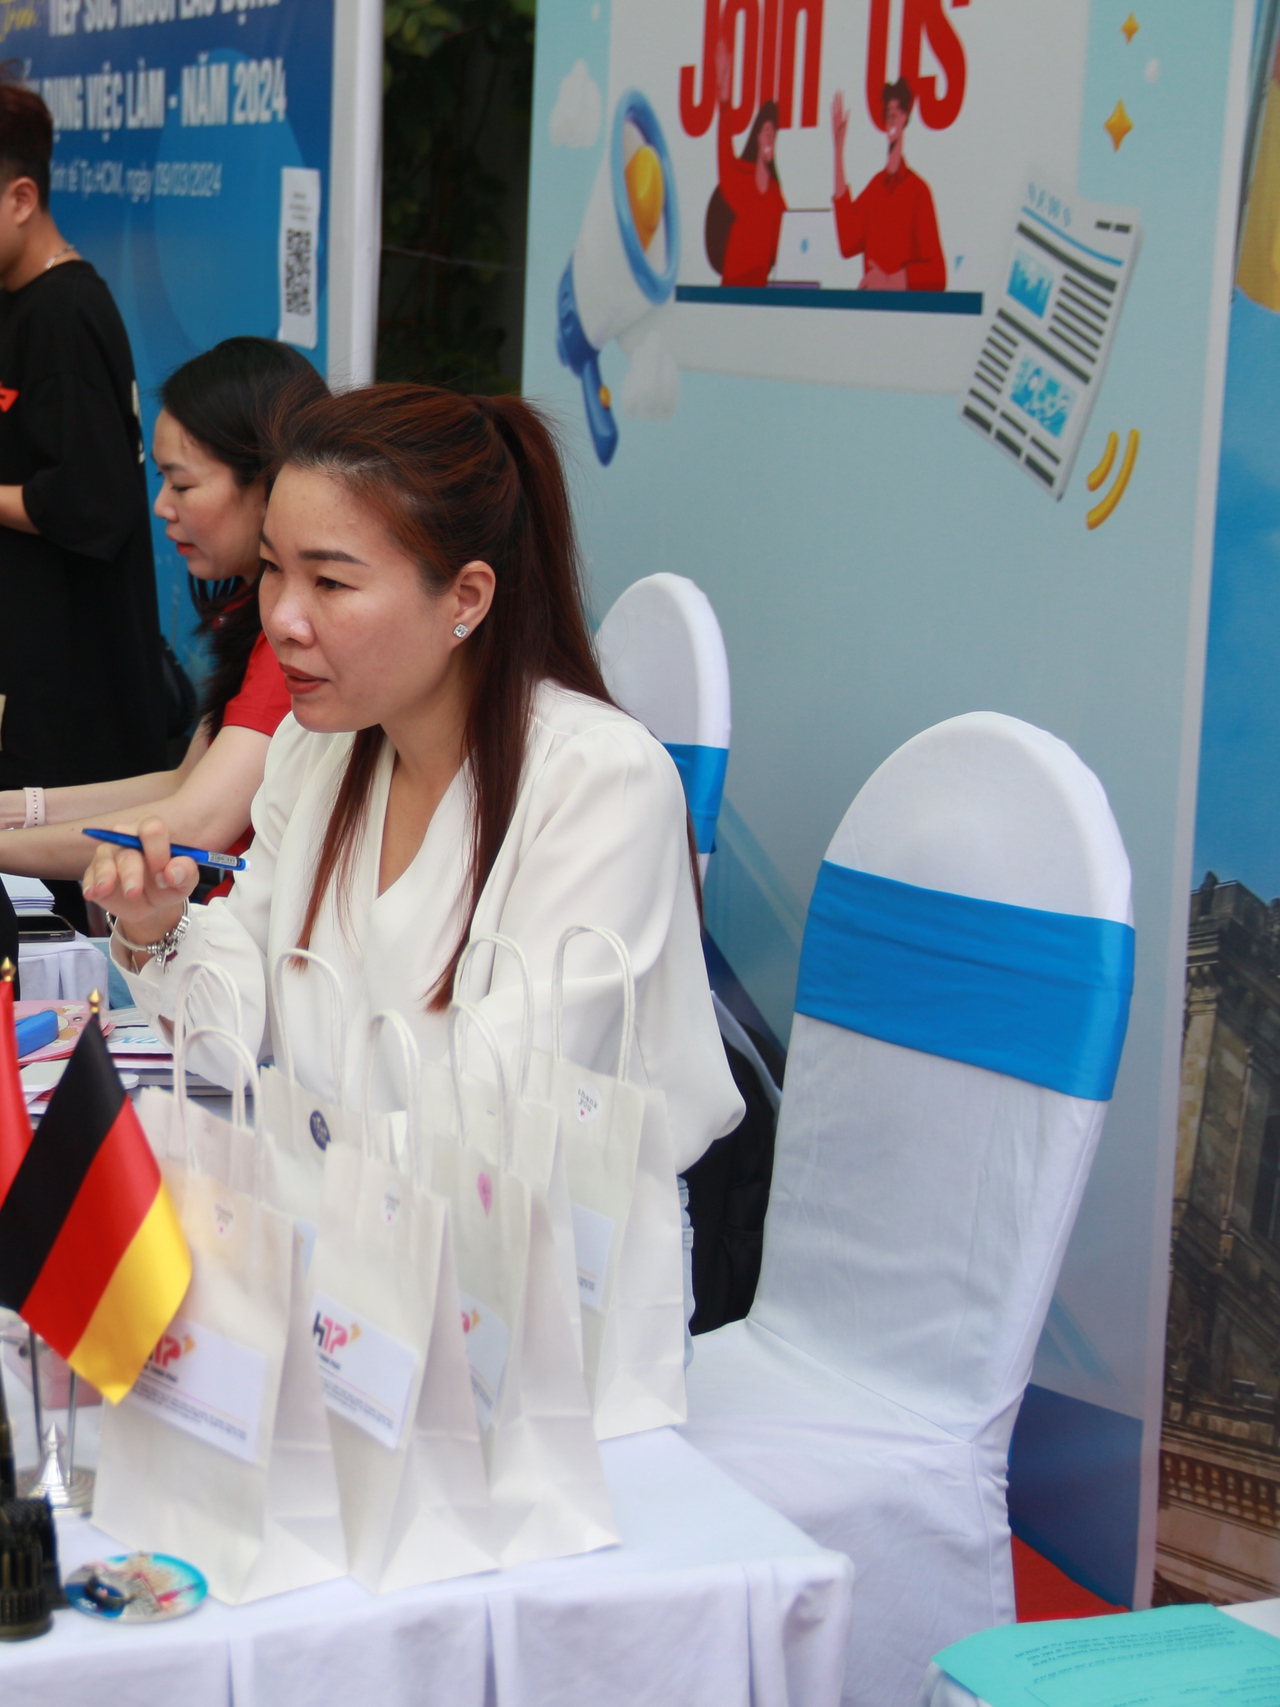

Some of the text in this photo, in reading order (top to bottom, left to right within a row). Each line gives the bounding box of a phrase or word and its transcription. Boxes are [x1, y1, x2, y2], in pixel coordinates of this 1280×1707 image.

[86, 60, 123, 143] VIỆC
[126, 57, 166, 129] LÀM
[181, 51, 230, 128] NĂM
[232, 56, 288, 124] 2024
[1027, 181, 1072, 228] NEWS
